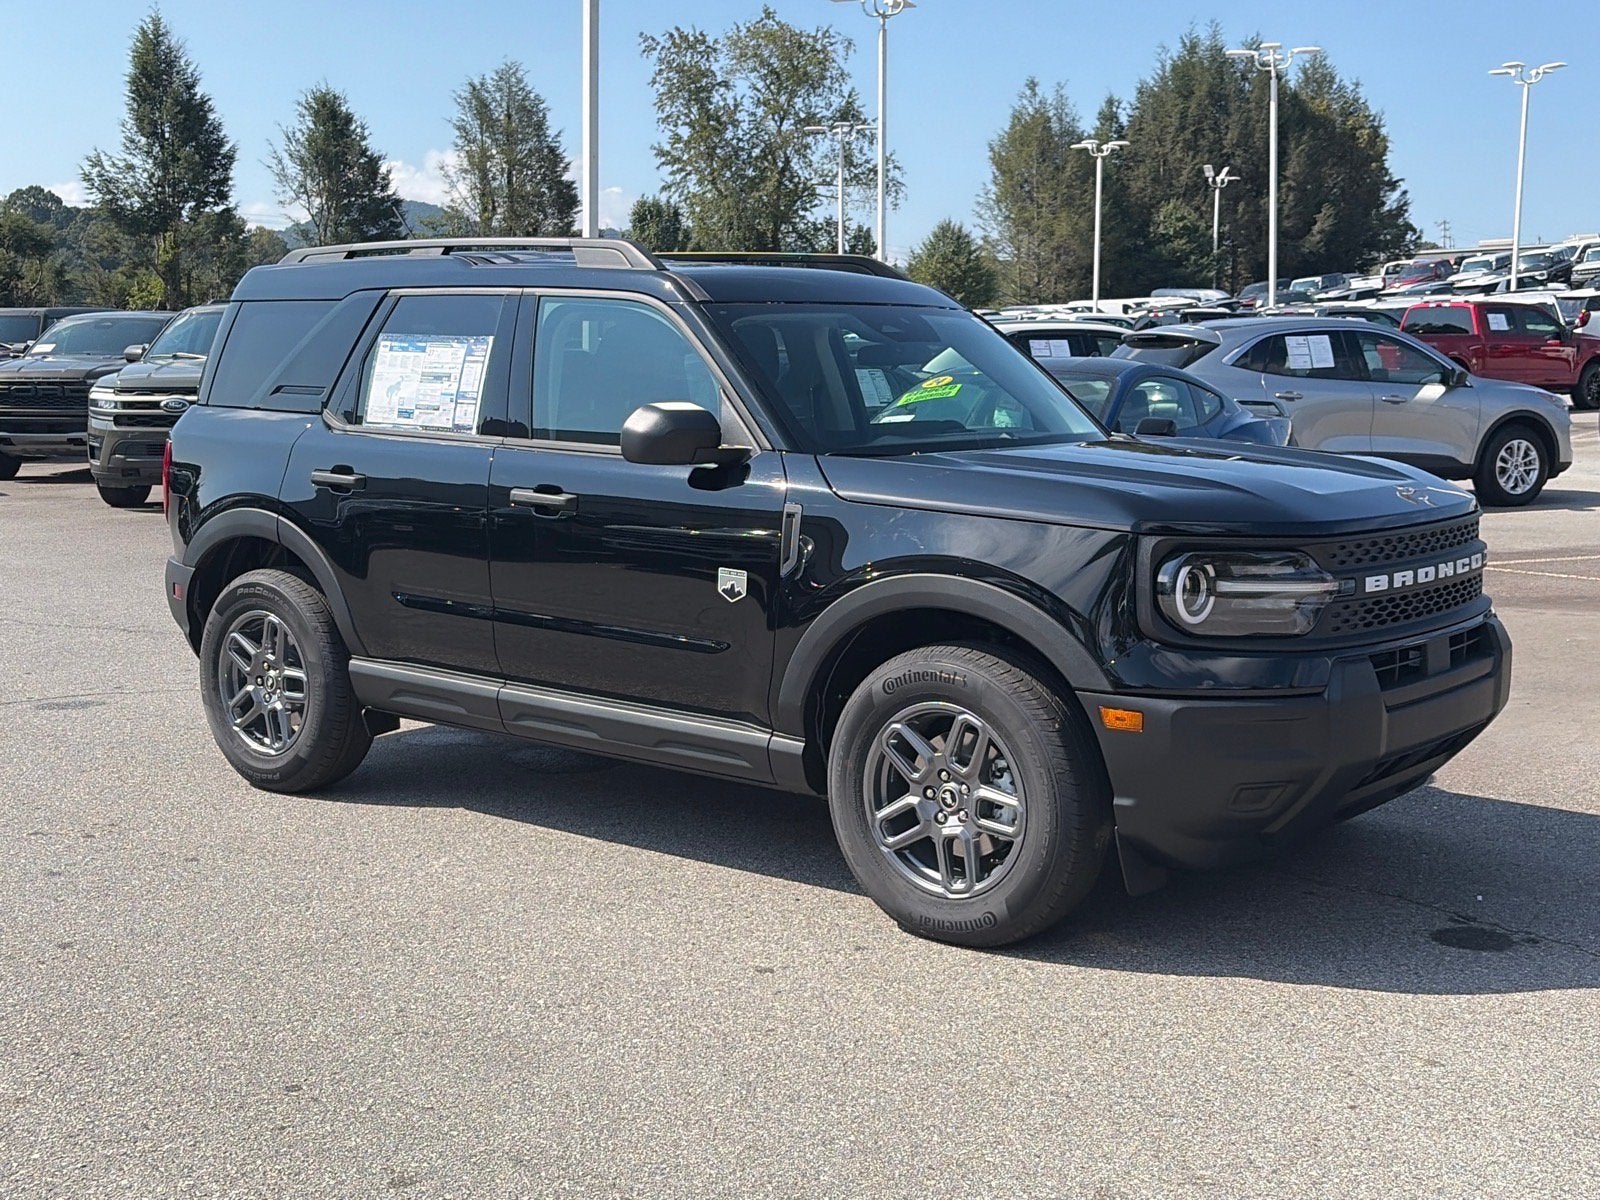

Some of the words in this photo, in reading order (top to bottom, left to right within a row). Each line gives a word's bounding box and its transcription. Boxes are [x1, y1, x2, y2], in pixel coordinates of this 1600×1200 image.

[1365, 553, 1482, 593] BRONCO
[882, 669, 958, 695] Continental
[919, 911, 998, 931] Continental
